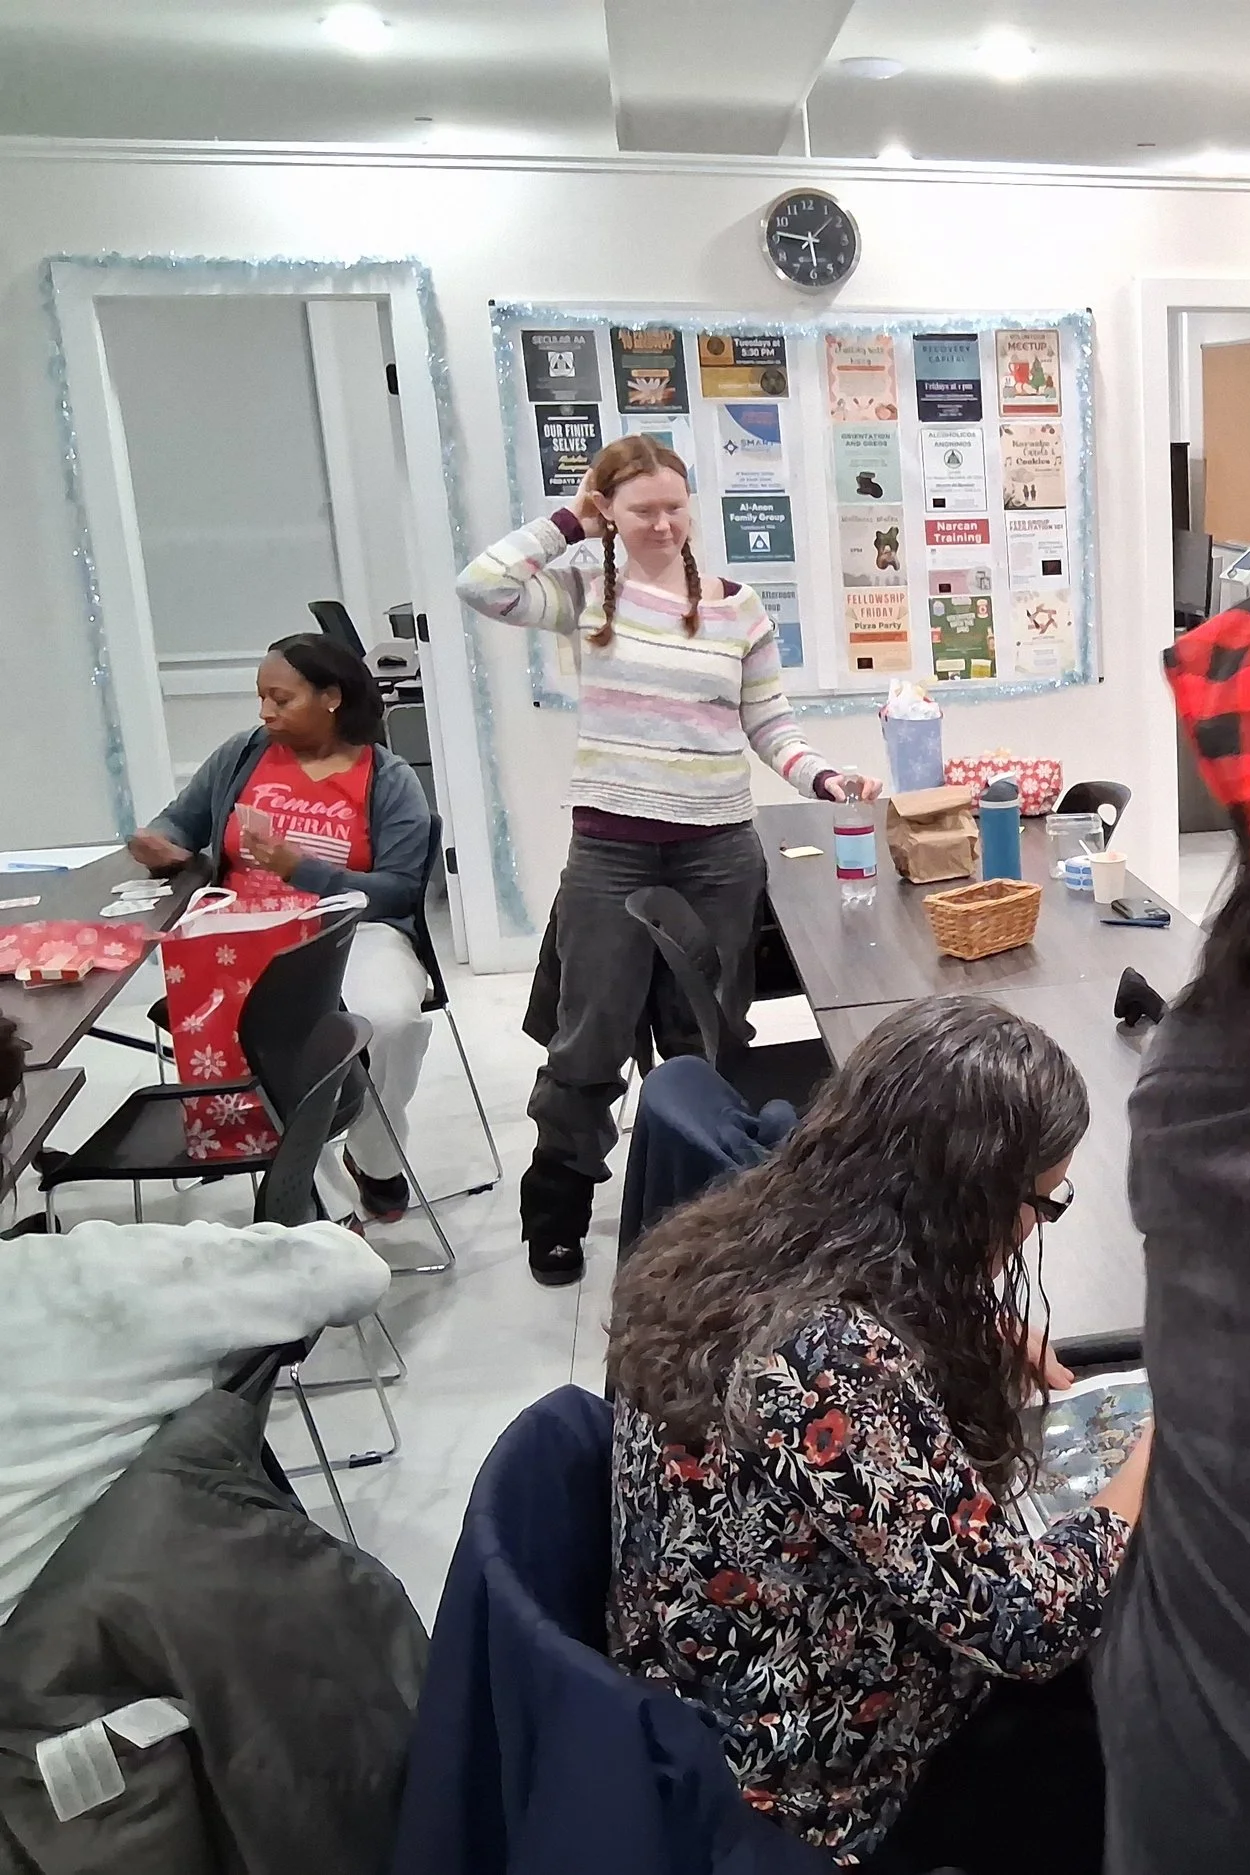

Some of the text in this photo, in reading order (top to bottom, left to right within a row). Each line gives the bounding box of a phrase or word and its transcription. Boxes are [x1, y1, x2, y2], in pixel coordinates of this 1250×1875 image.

[786, 205, 798, 215] 11
[801, 200, 814, 210] 12
[823, 205, 828, 215] 1
[776, 217, 789, 227] 10
[835, 216, 842, 228] 2
[810, 268, 817, 279] 6
[734, 338, 781, 349] Tuesdays at
[922, 344, 971, 353] RECOVERY
[1007, 341, 1047, 351] MEETUP
[761, 348, 775, 357] PM
[925, 383, 949, 391] Fridays
[543, 423, 596, 438] OUR FINITE
[552, 438, 587, 452] SELVES
[1016, 457, 1051, 465] Cookies
[739, 503, 774, 511] Al-Anon
[729, 513, 786, 523] Family Group
[936, 521, 978, 531] Narcan
[934, 532, 982, 543] Training
[761, 591, 796, 599] Afternoon
[847, 593, 905, 605] FELLOWSHIP
[764, 603, 781, 612] roup
[861, 606, 894, 618] FRIDAY
[854, 621, 902, 630] Pizza Party
[253, 783, 357, 821] Female
[272, 813, 351, 840] TERAN
